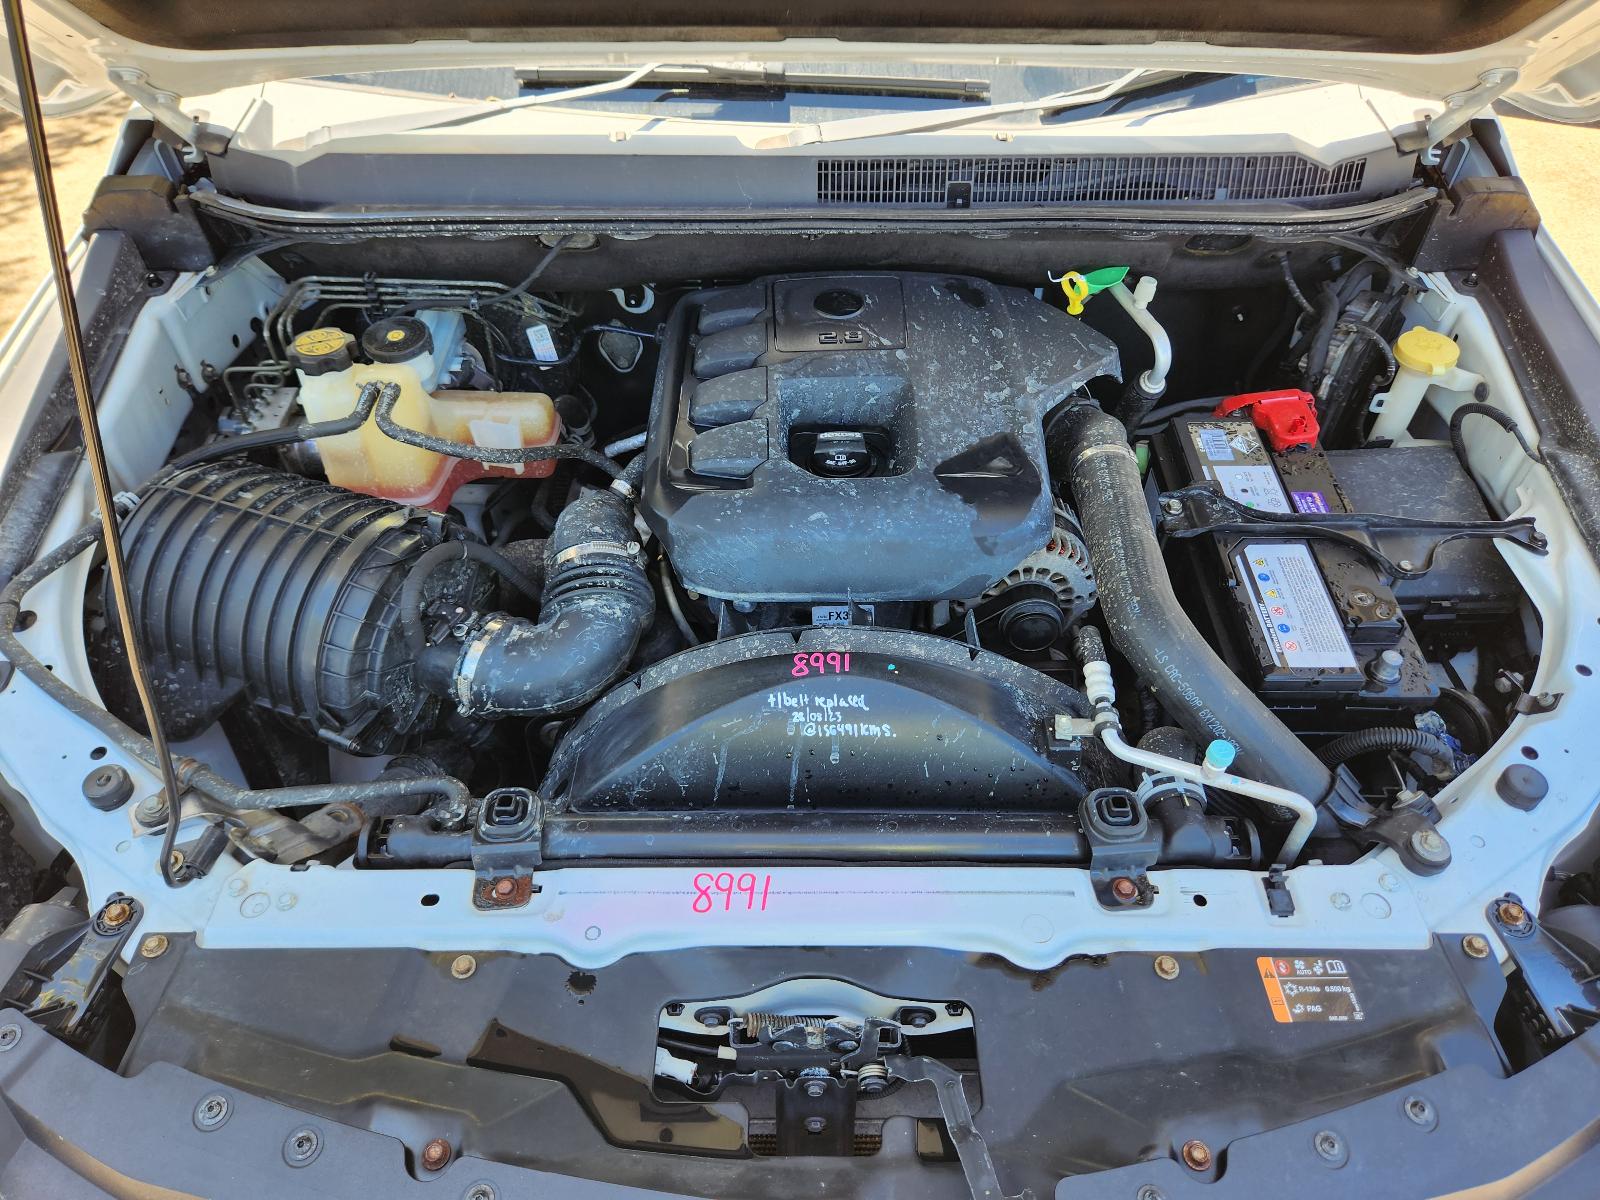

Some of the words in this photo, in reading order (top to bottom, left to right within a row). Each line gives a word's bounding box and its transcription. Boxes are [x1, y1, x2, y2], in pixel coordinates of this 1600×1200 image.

[818, 331, 863, 344] 2.8
[791, 651, 850, 676] 8991
[815, 690, 870, 711] replaced
[692, 871, 771, 913] 8991
[1306, 1004, 1322, 1013] PAG
